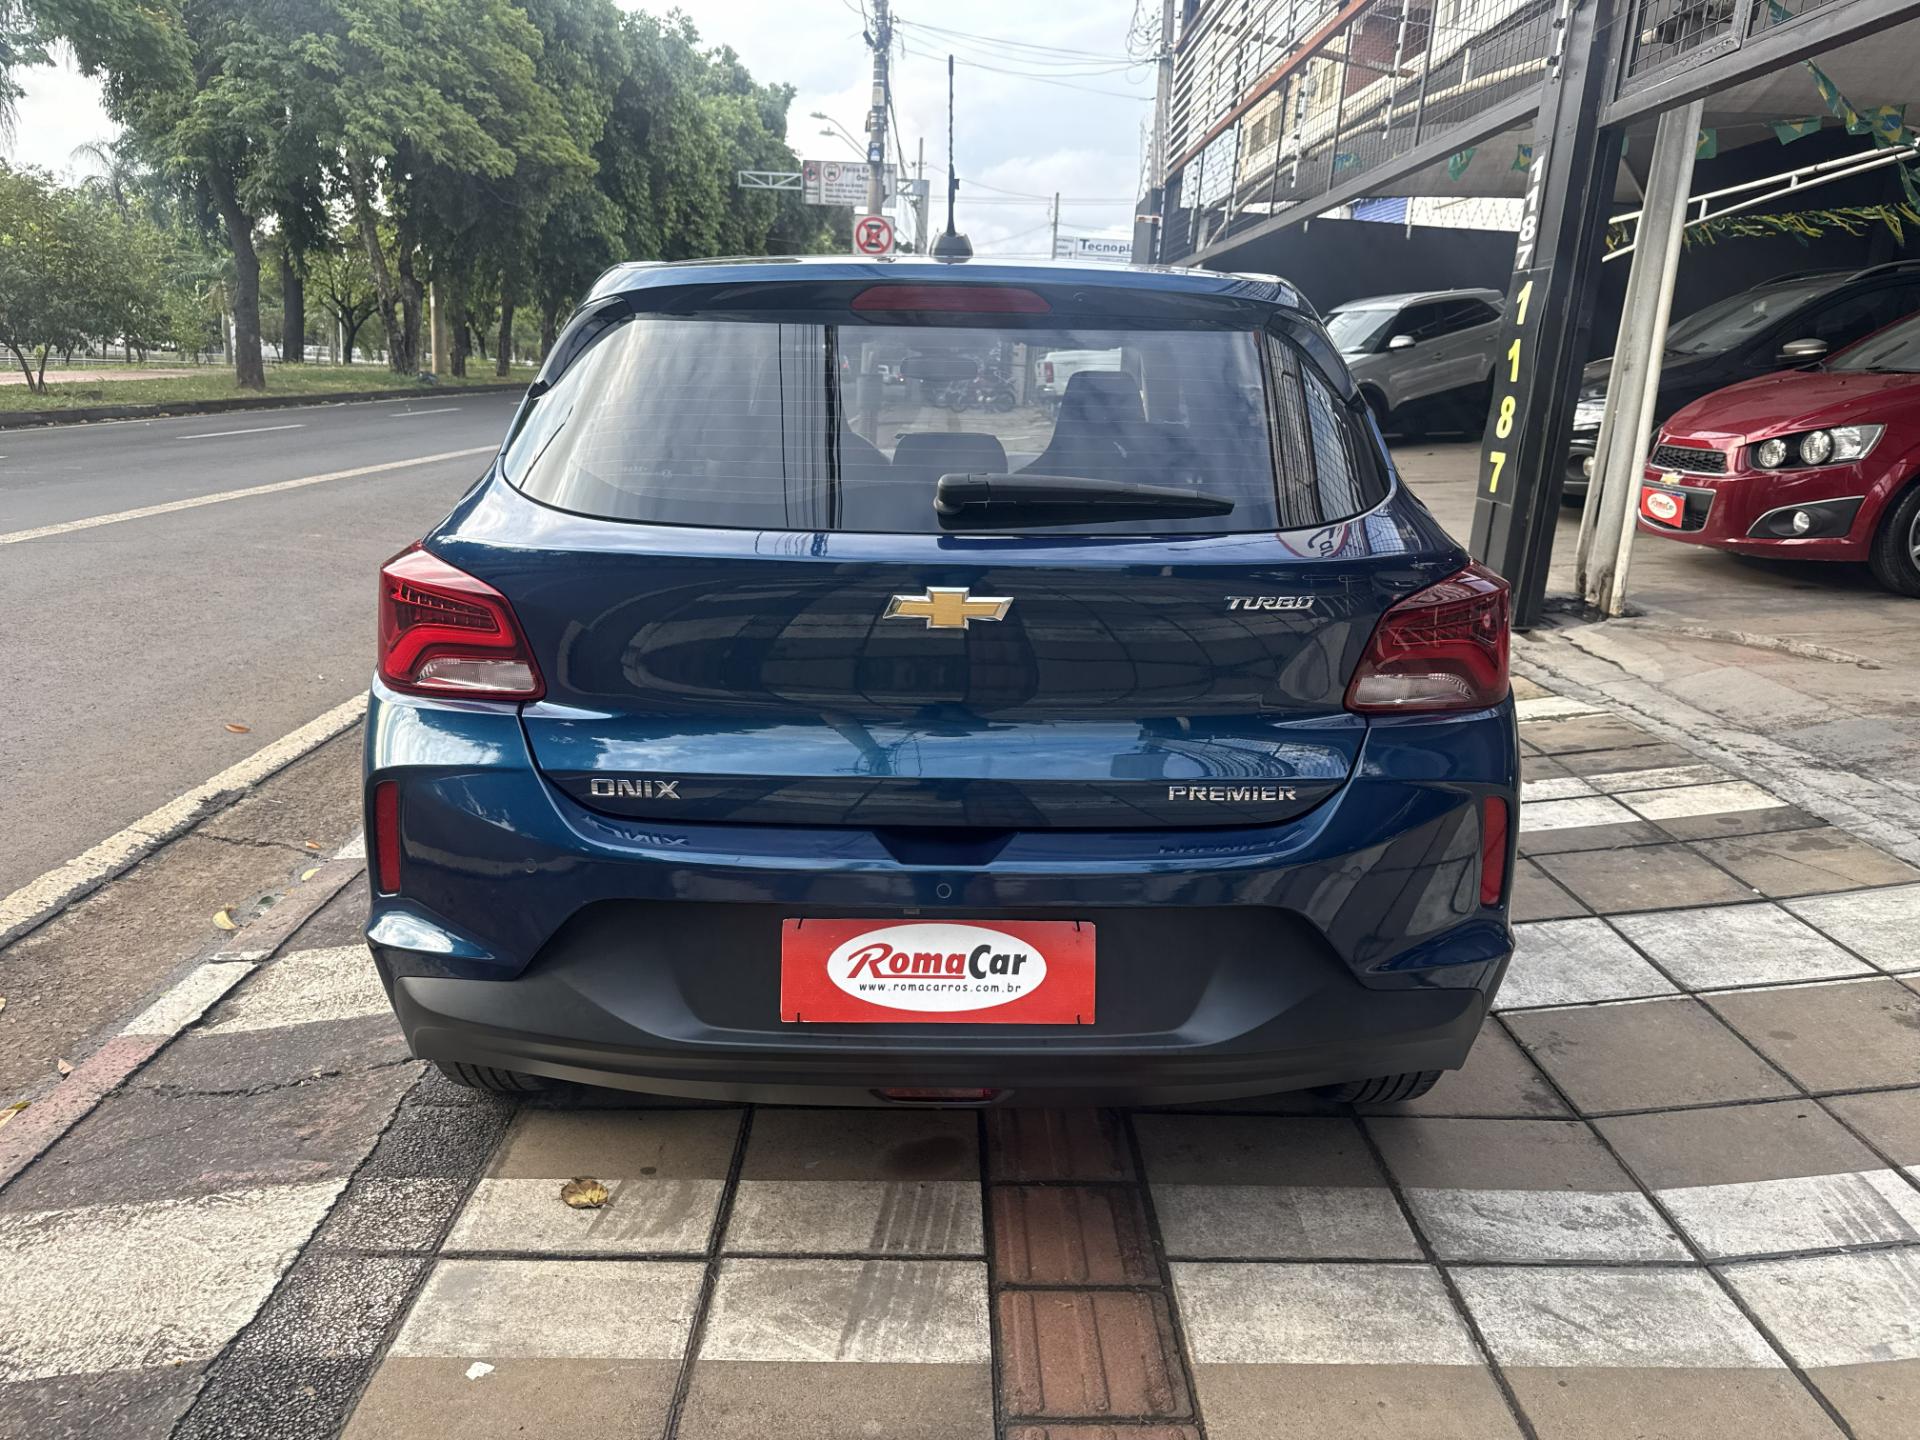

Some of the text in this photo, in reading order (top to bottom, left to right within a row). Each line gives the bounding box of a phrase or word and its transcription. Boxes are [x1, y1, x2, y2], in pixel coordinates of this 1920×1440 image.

[1515, 154, 1545, 270] 1187
[1079, 238, 1134, 254] Tecnopl
[1488, 280, 1534, 494] 1187
[1224, 595, 1316, 610] TURBO
[590, 778, 681, 800] ONIX
[1168, 786, 1297, 801] PREMIER
[846, 943, 1027, 980] RomaCar
[859, 982, 1021, 993] www.romacarros.com.br
